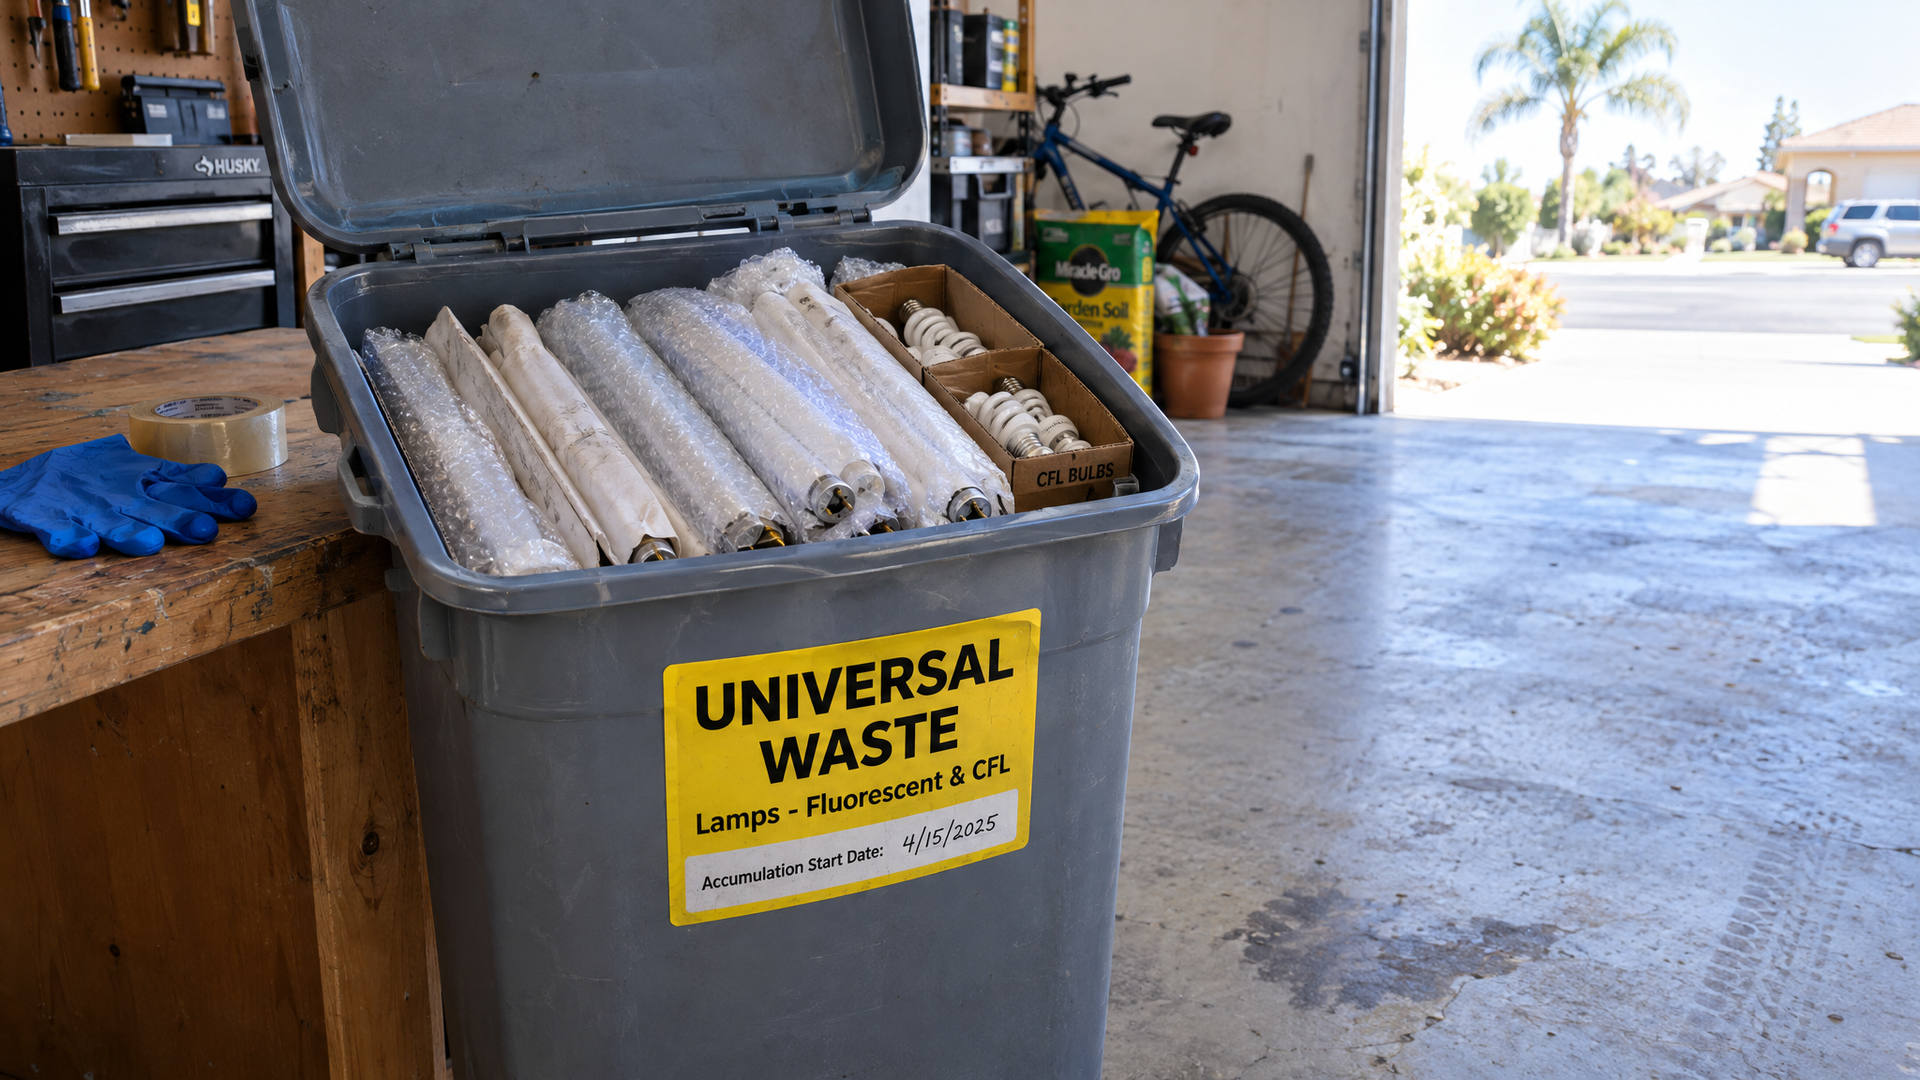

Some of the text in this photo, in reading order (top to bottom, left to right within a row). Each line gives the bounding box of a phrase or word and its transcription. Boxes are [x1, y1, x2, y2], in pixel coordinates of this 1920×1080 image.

[214, 158, 260, 174] HUSKY
[1052, 297, 1129, 319] arden Soil
[1037, 462, 1114, 487] CFL BULBS
[695, 638, 1014, 730] UNIVERSAL
[759, 705, 959, 784] WASTE
[696, 807, 780, 835] Lamps
[806, 771, 943, 817] Fluorescent
[949, 765, 966, 787] &
[972, 754, 1011, 781] CFL
[902, 813, 999, 856] 4/15/2025
[701, 845, 884, 890] Accumulation Start Date:
